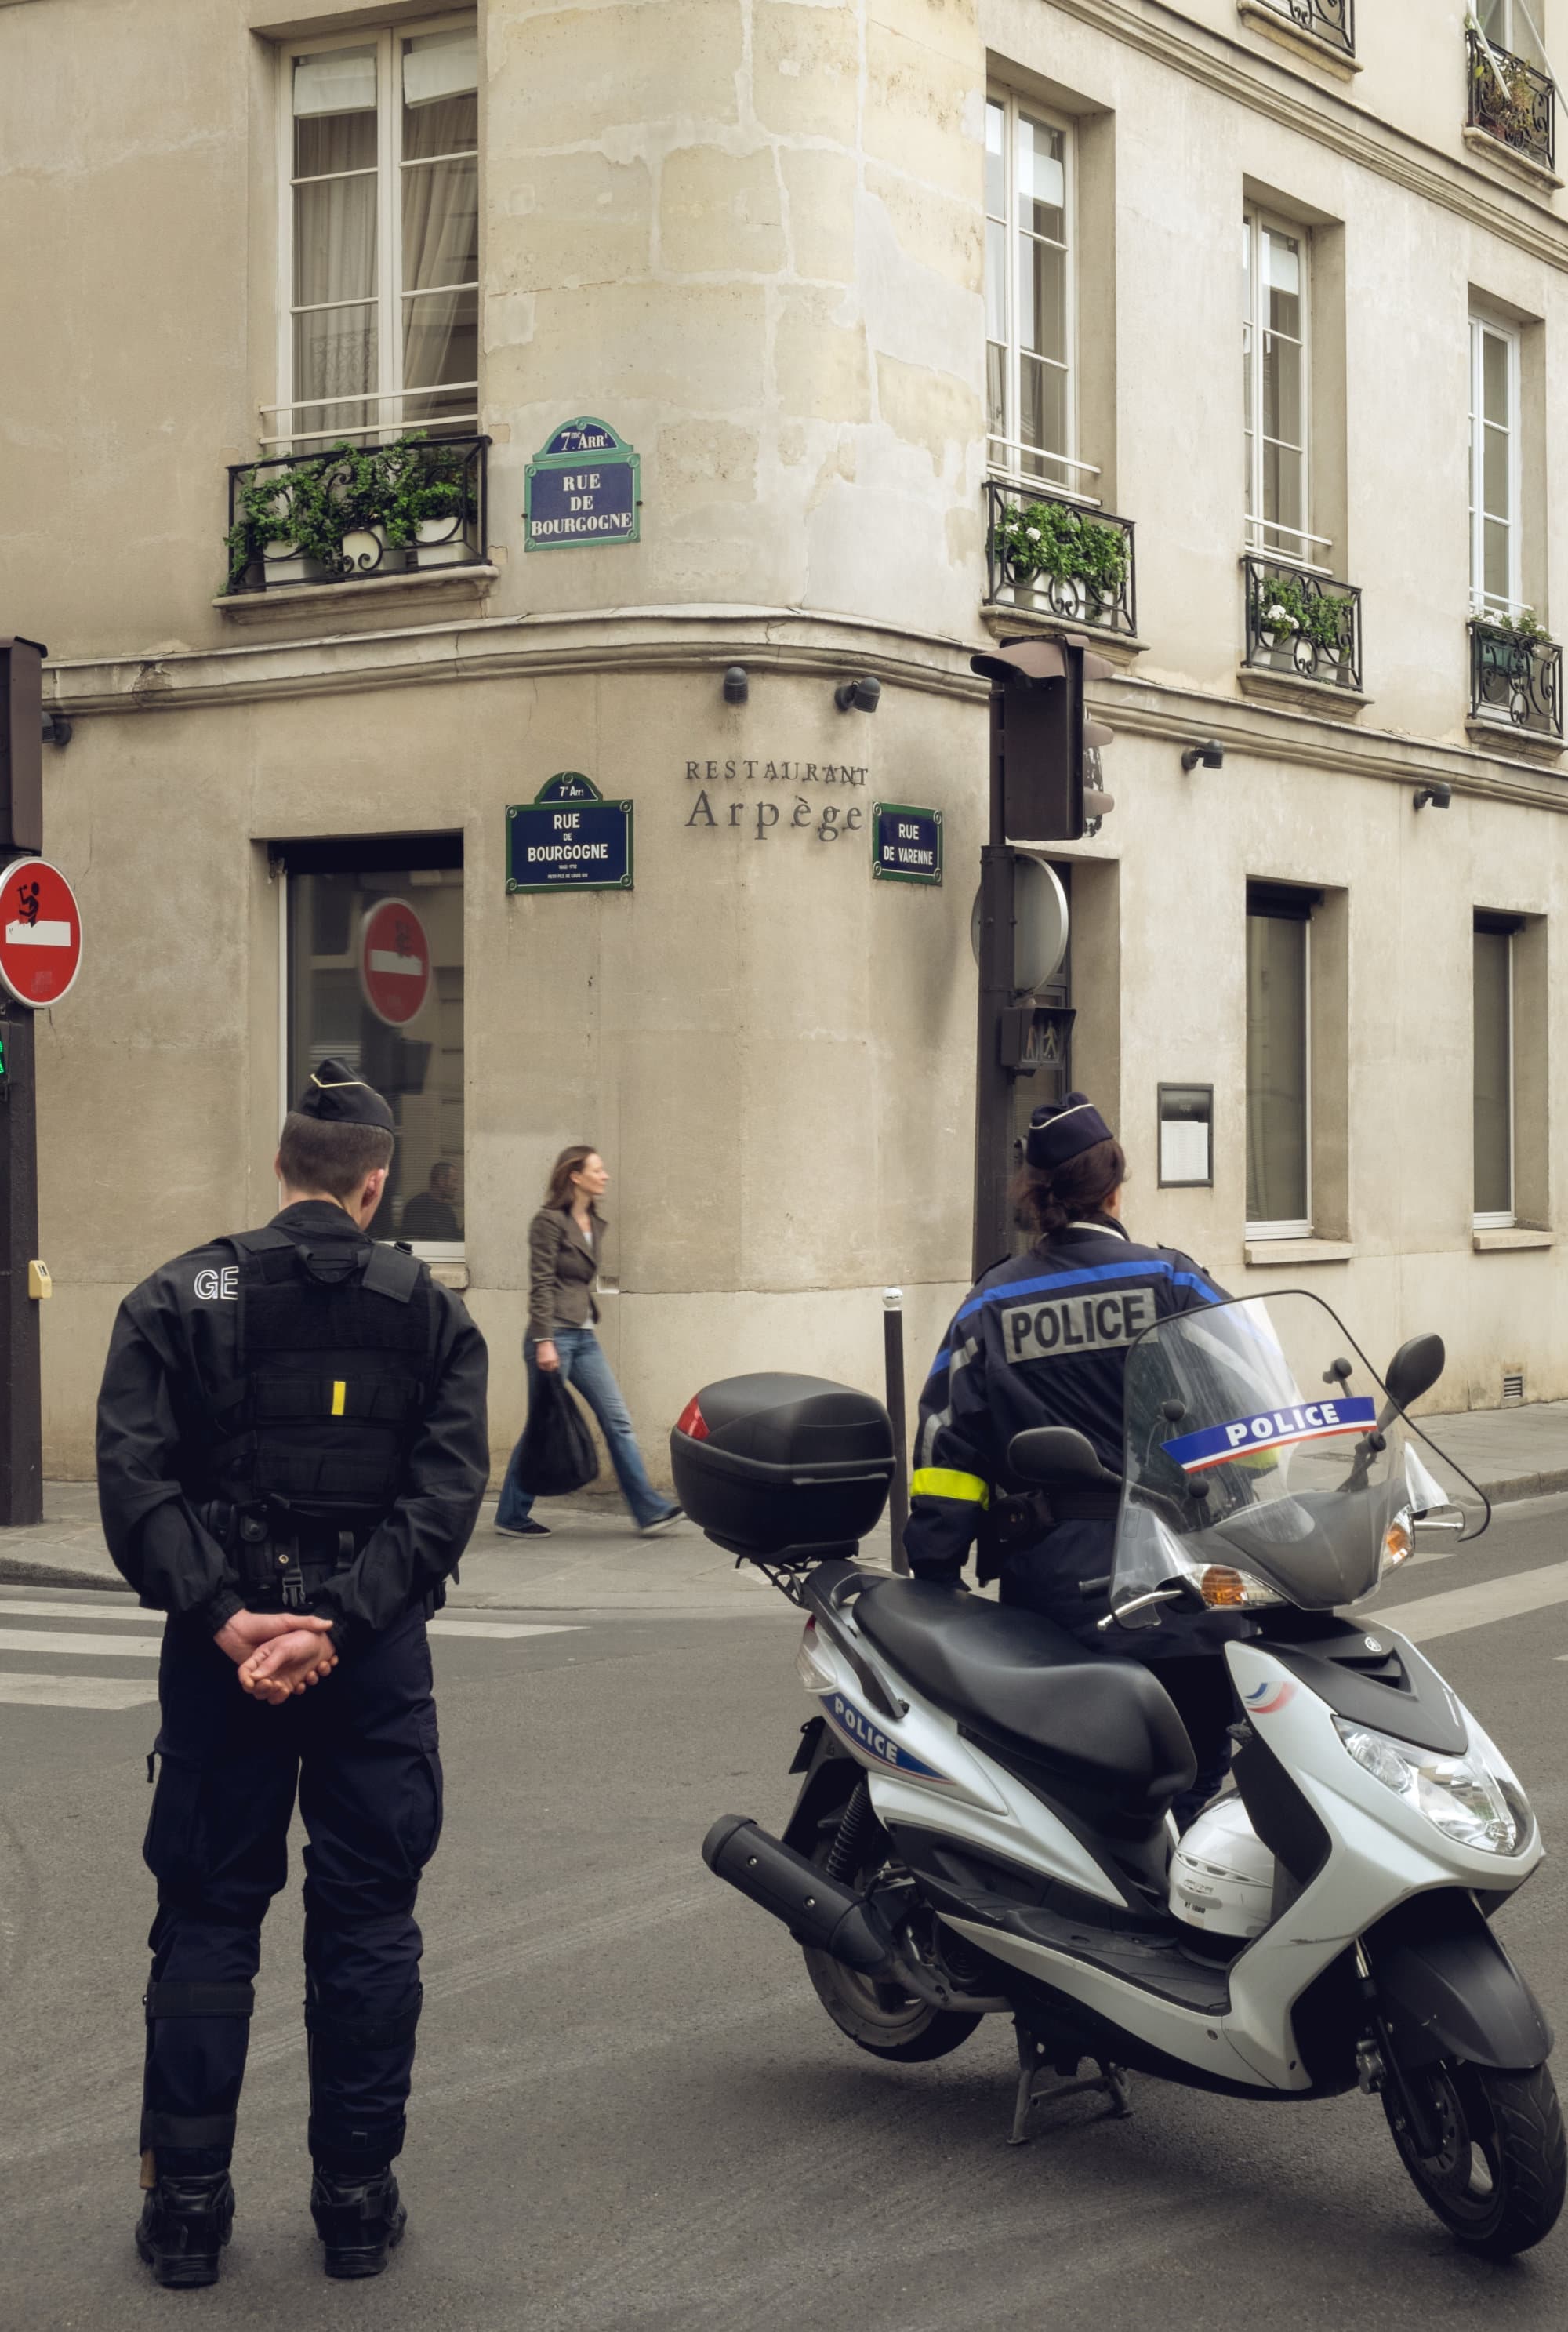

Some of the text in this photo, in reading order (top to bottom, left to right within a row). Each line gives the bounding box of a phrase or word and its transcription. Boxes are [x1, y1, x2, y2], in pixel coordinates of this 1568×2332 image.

[563, 474, 601, 492] RUE
[570, 496, 593, 511] DE
[532, 512, 632, 536] BOURGOGNE
[685, 760, 869, 786] RESTAURANT
[554, 813, 580, 830] RUE
[684, 790, 862, 842] Arpège
[563, 833, 572, 841] DE
[898, 823, 920, 841] RUE
[528, 844, 608, 862] BOURGOGNE
[884, 845, 933, 866] DE VARENNE
[1011, 1295, 1145, 1355] POLICE
[1225, 1404, 1340, 1447] POLICE
[834, 1696, 898, 1764] POLICE
